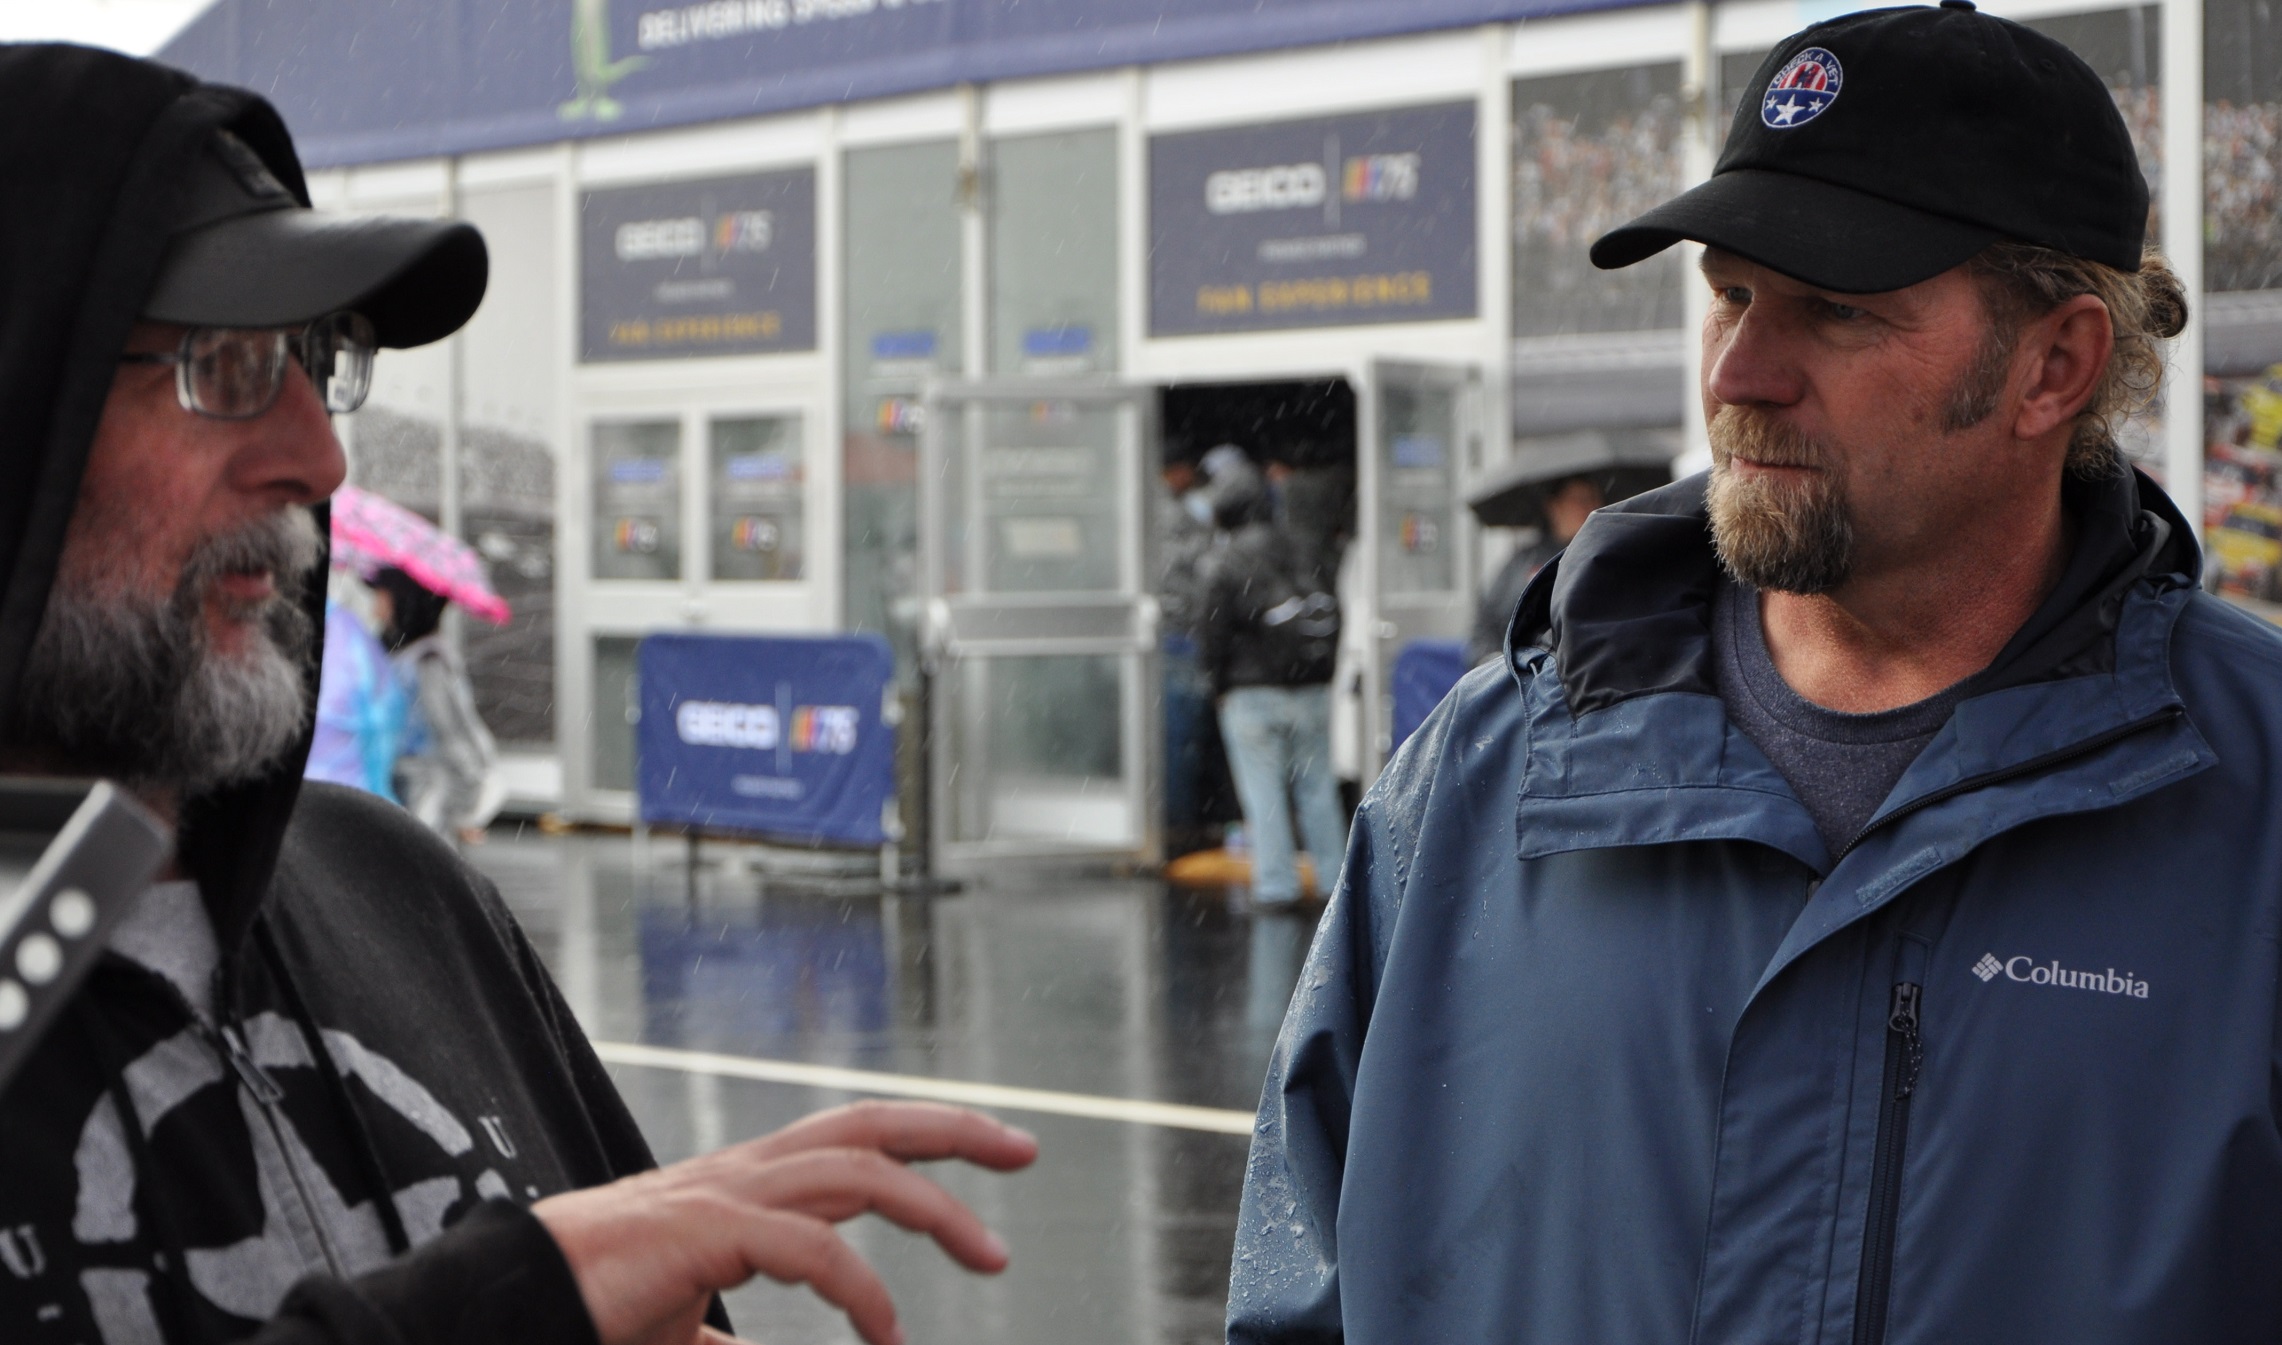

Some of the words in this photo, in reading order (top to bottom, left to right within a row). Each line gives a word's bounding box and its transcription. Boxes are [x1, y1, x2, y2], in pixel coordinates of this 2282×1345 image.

[639, 0, 790, 50] DELIVERING
[1815, 53, 1824, 63] A
[1826, 60, 1839, 86] VET
[1205, 162, 1326, 215] GEICO
[676, 700, 780, 750] GEICO
[2005, 955, 2149, 999] Columbia
